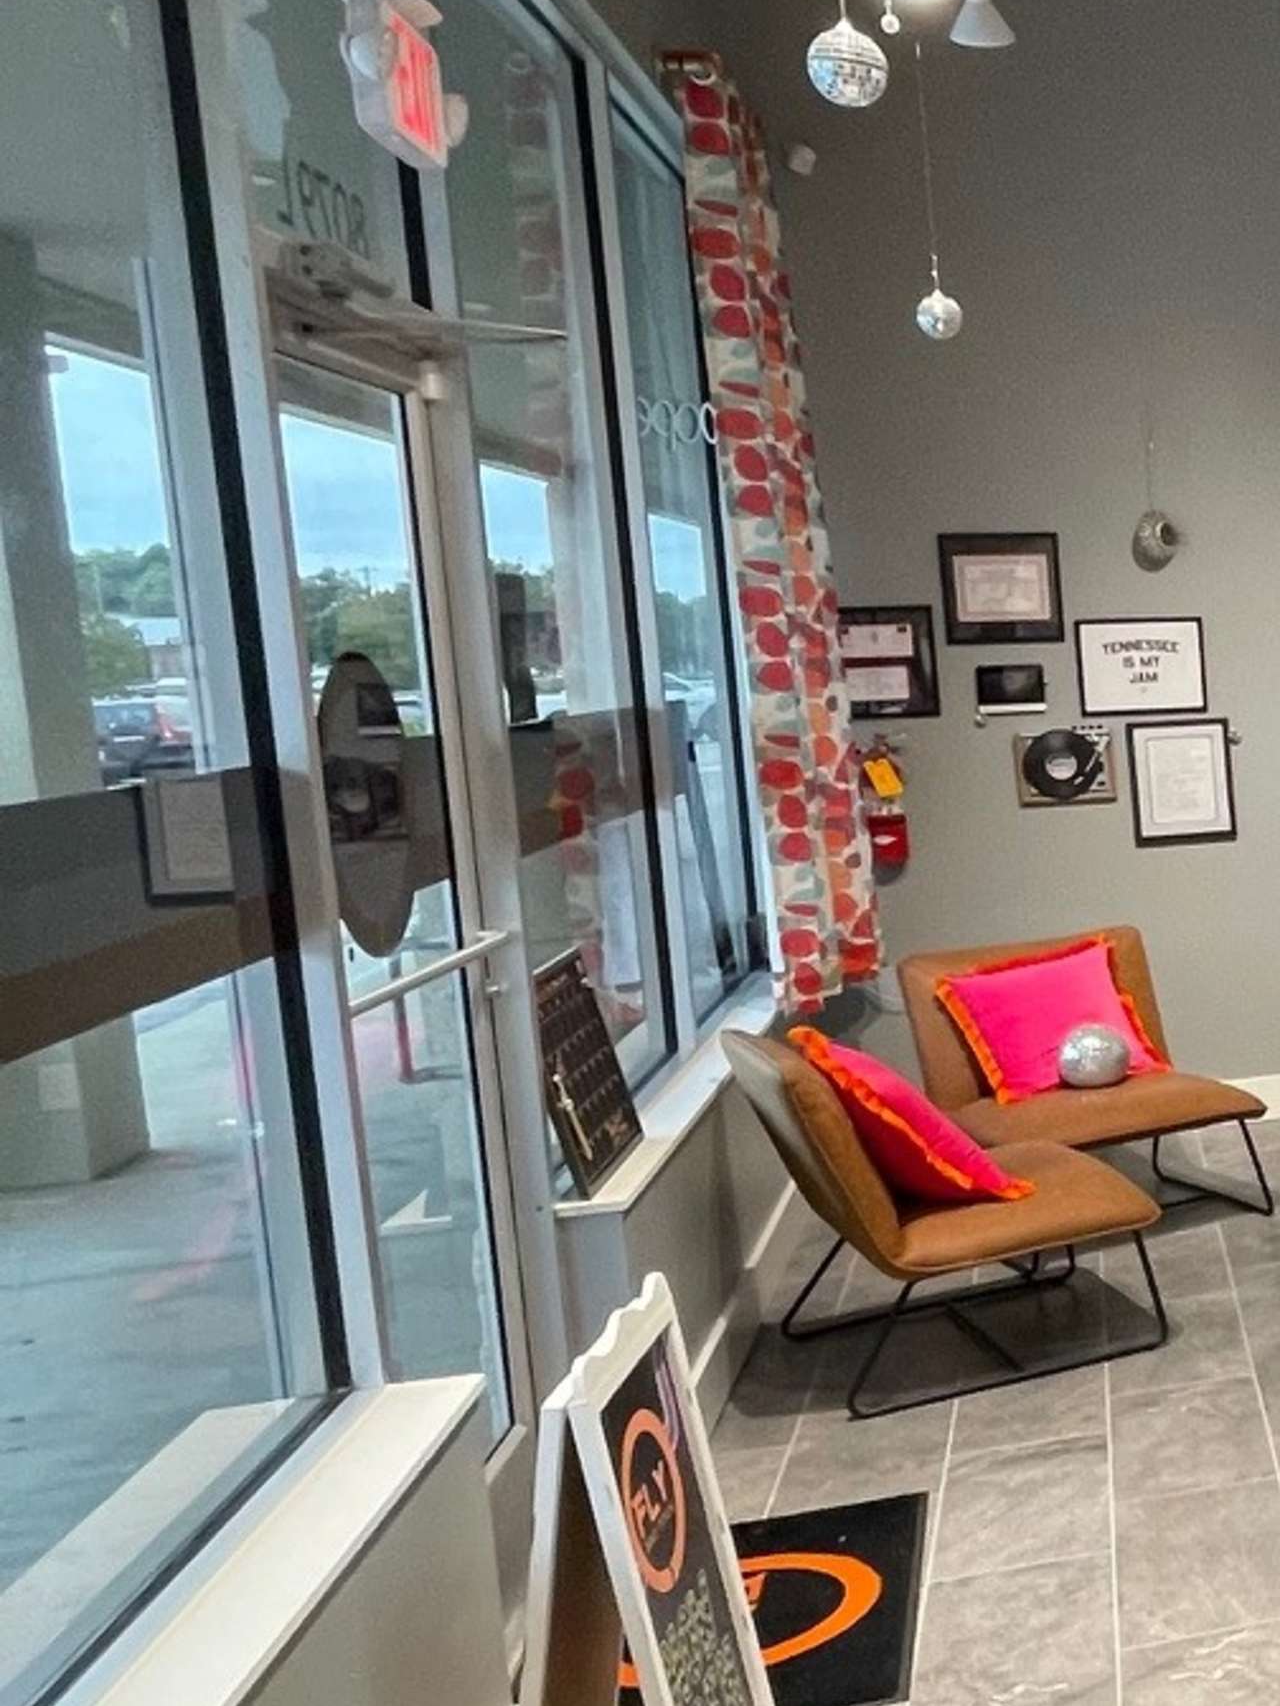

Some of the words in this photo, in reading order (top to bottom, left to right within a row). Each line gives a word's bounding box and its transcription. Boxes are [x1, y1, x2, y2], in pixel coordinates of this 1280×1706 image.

[1102, 639, 1180, 654] TENNESSEE
[1122, 655, 1135, 668] IS
[1140, 656, 1159, 668] MY
[1128, 671, 1158, 684] JAM
[629, 1459, 669, 1541] FLY
